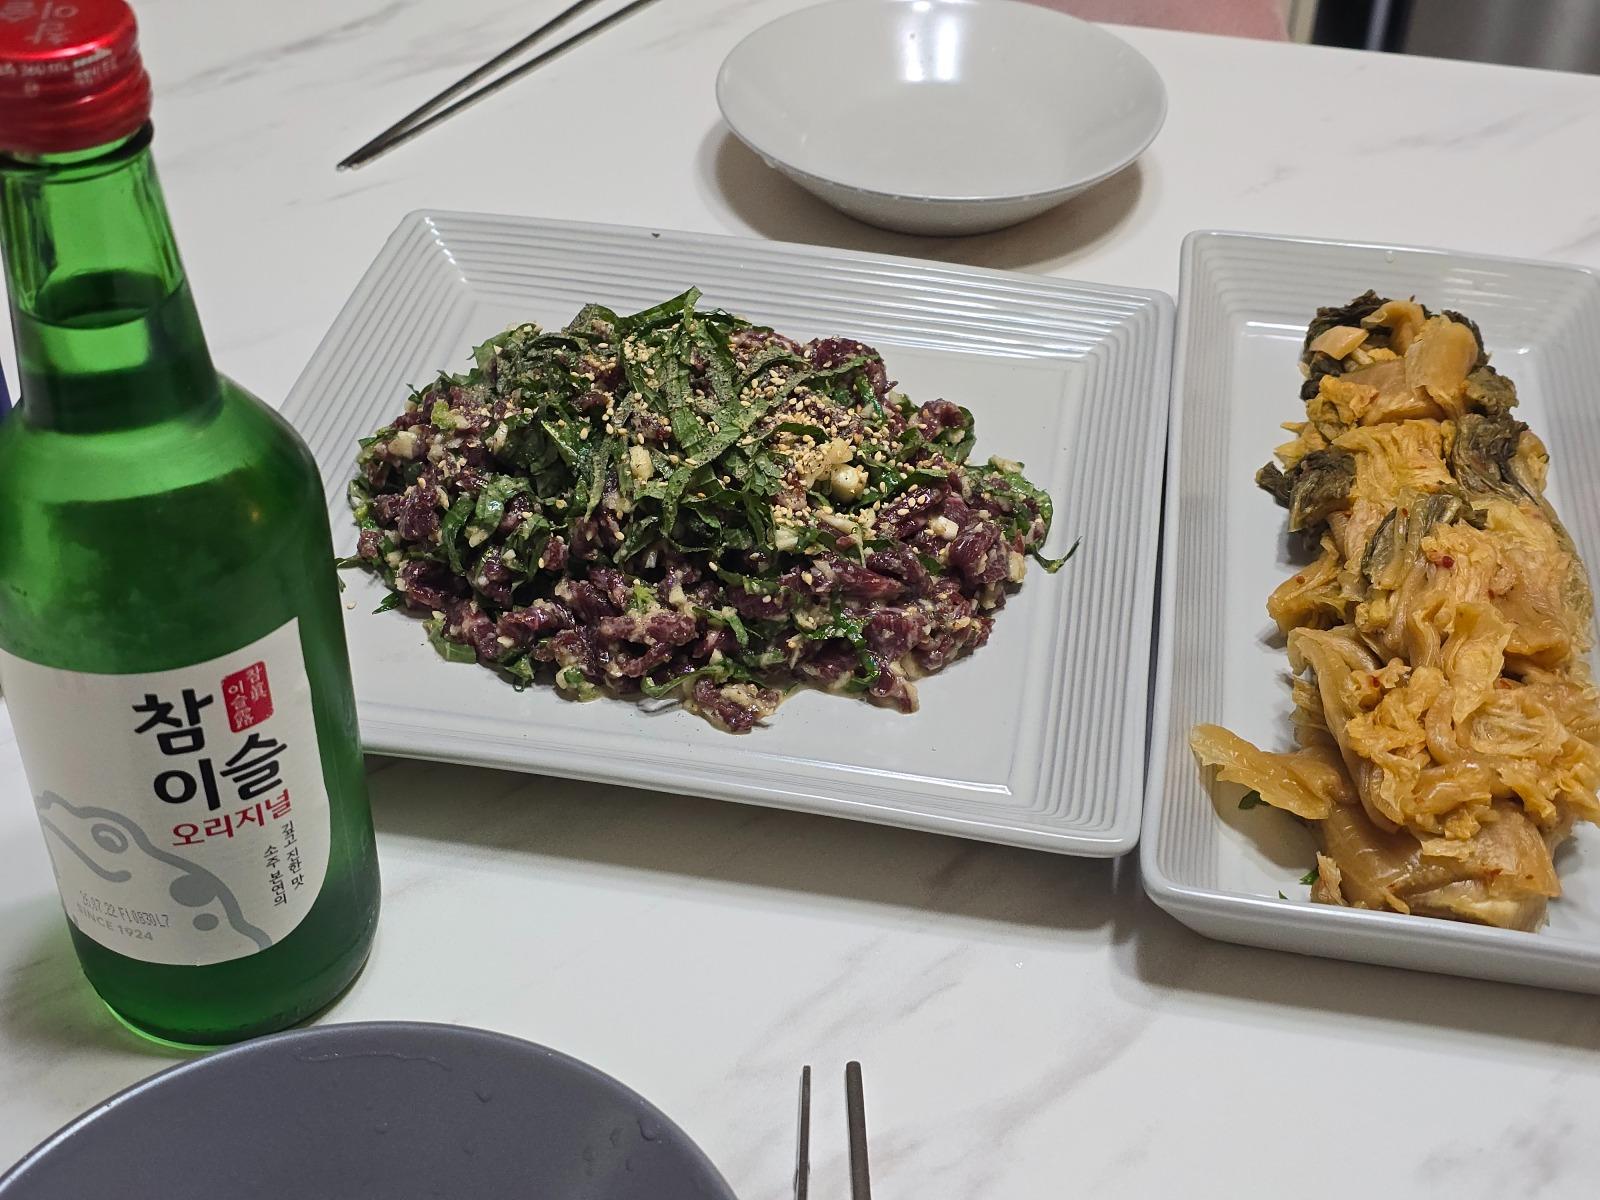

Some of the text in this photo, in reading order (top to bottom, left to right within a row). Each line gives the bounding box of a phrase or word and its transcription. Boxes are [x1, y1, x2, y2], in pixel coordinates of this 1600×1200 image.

[132, 688, 214, 756] 참
[153, 732, 288, 811] 이슬
[172, 788, 292, 847] 오리지널
[263, 845, 288, 907] 소주 본연의
[281, 819, 305, 891] 깊고 진한 맛
[77, 903, 155, 941] SINCE 1924
